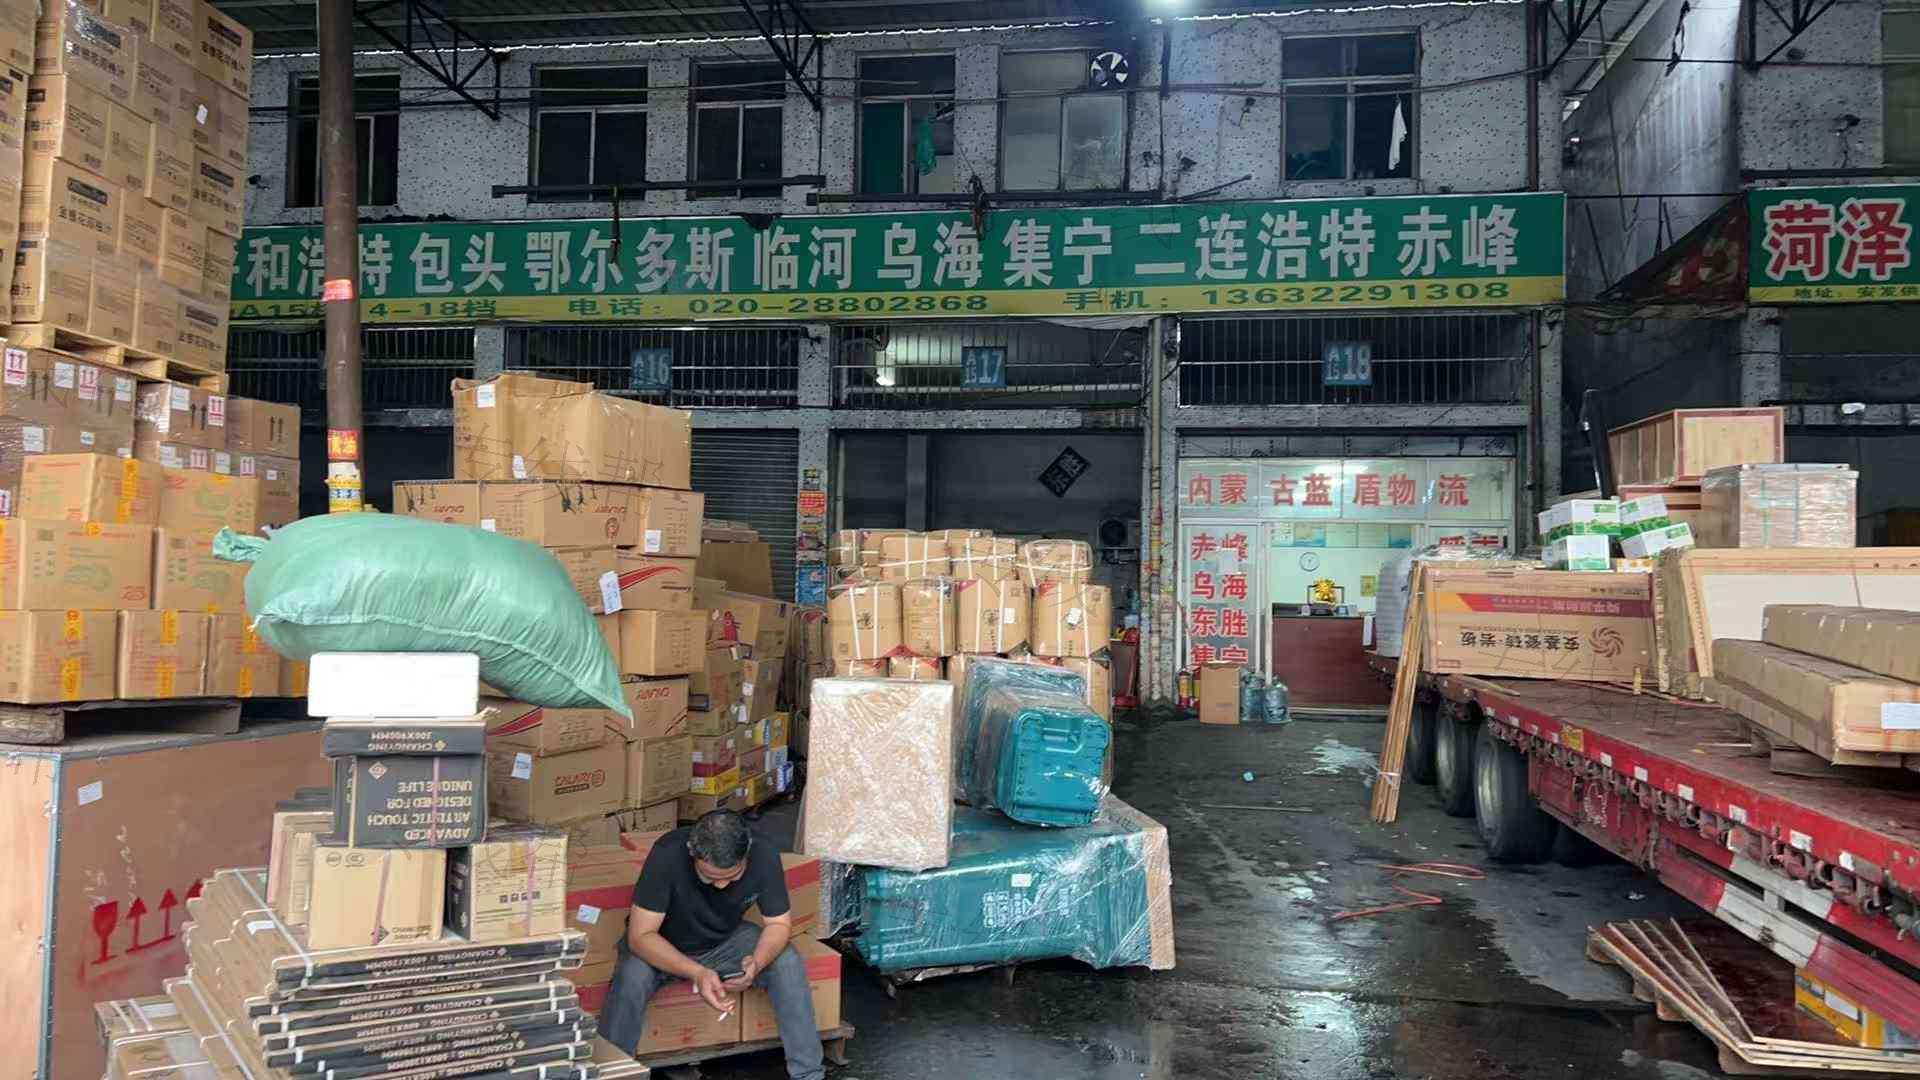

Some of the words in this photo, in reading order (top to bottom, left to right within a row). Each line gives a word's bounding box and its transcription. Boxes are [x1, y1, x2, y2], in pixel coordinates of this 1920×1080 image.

[1763, 198, 1912, 281] 菏泽
[409, 231, 506, 294] 包头
[525, 227, 734, 293] 鄂尔多斯
[754, 225, 857, 290] 临河
[877, 221, 983, 289] 乌海
[1002, 217, 1112, 288] 集宁
[1135, 208, 1375, 281] 二连浩特
[1396, 204, 1520, 276] 赤峰
[1191, 532, 1248, 561] 赤峰
[1191, 571, 1248, 600] 乌海
[1191, 607, 1248, 638] 东胜
[398, 781, 424, 793] LIFE
[426, 780, 472, 792] UNIQE
[387, 797, 410, 809] FOR
[367, 814, 409, 826] TOUCH
[412, 812, 471, 824] ARTITIC
[404, 827, 471, 841] ADVACED
